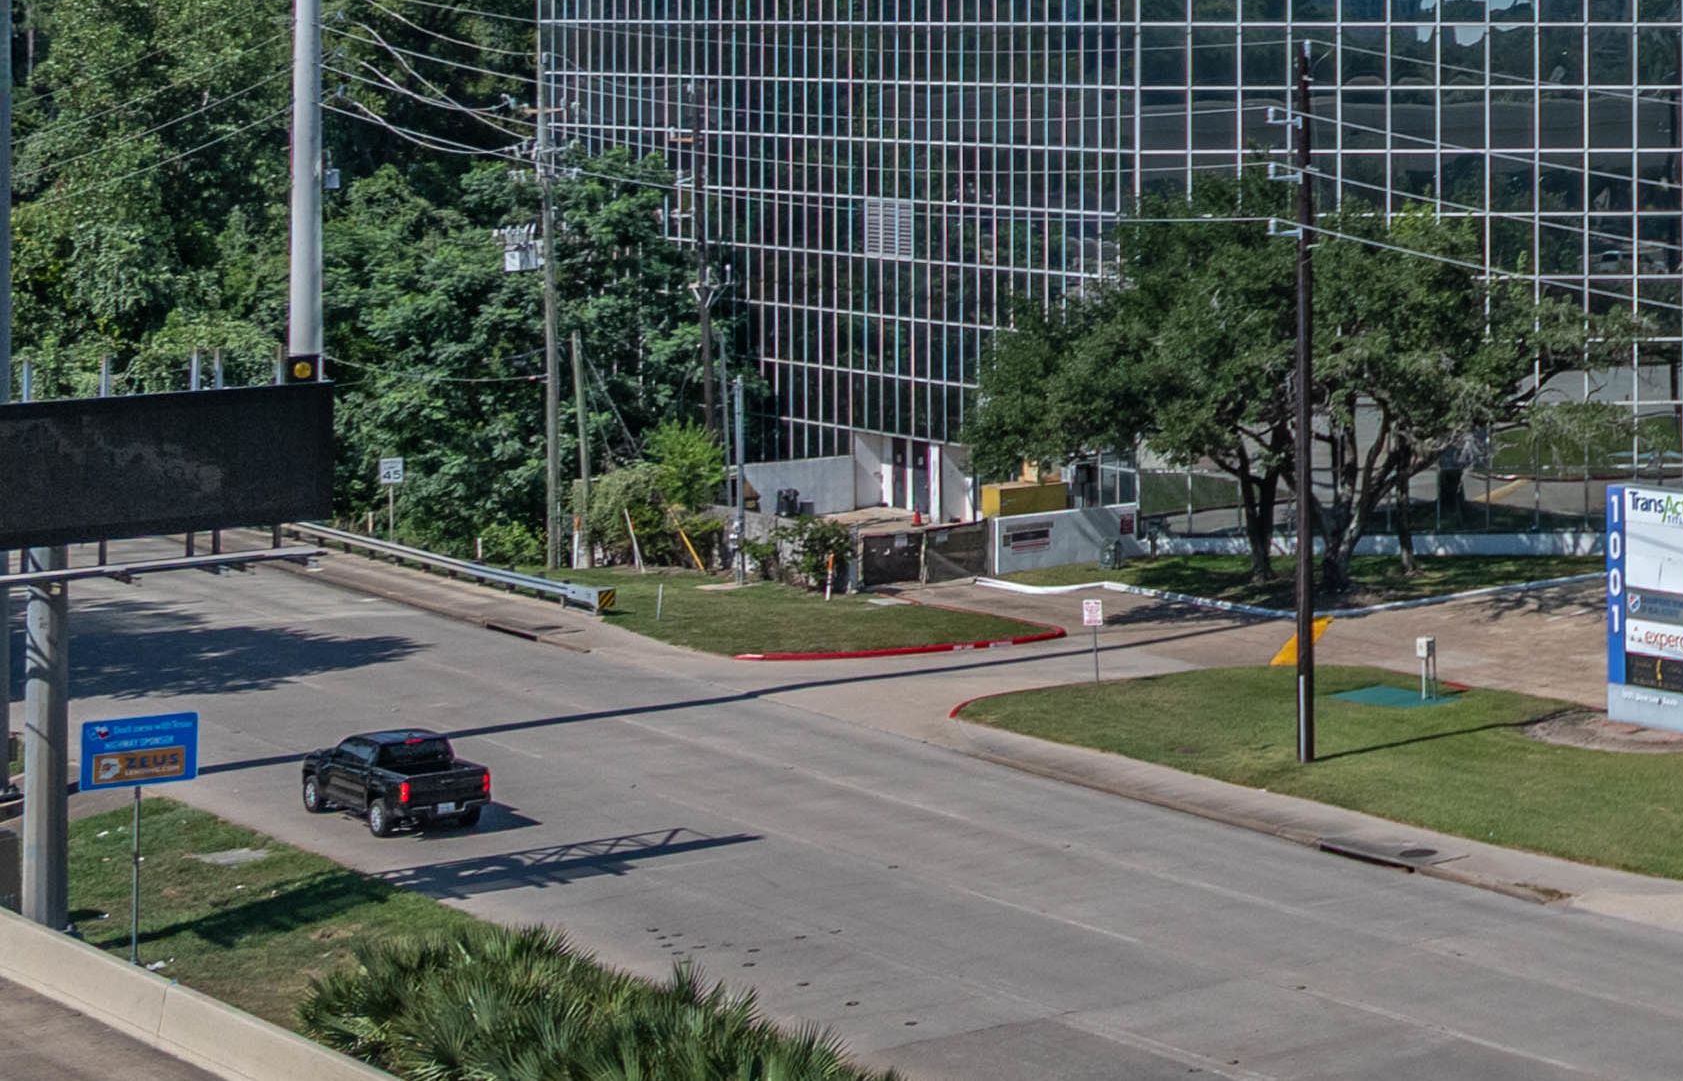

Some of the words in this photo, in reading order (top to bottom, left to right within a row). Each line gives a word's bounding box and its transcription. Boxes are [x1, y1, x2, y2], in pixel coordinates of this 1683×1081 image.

[383, 469, 401, 479] 45
[1609, 495, 1621, 633] 1001
[125, 753, 179, 769] ZEUS
